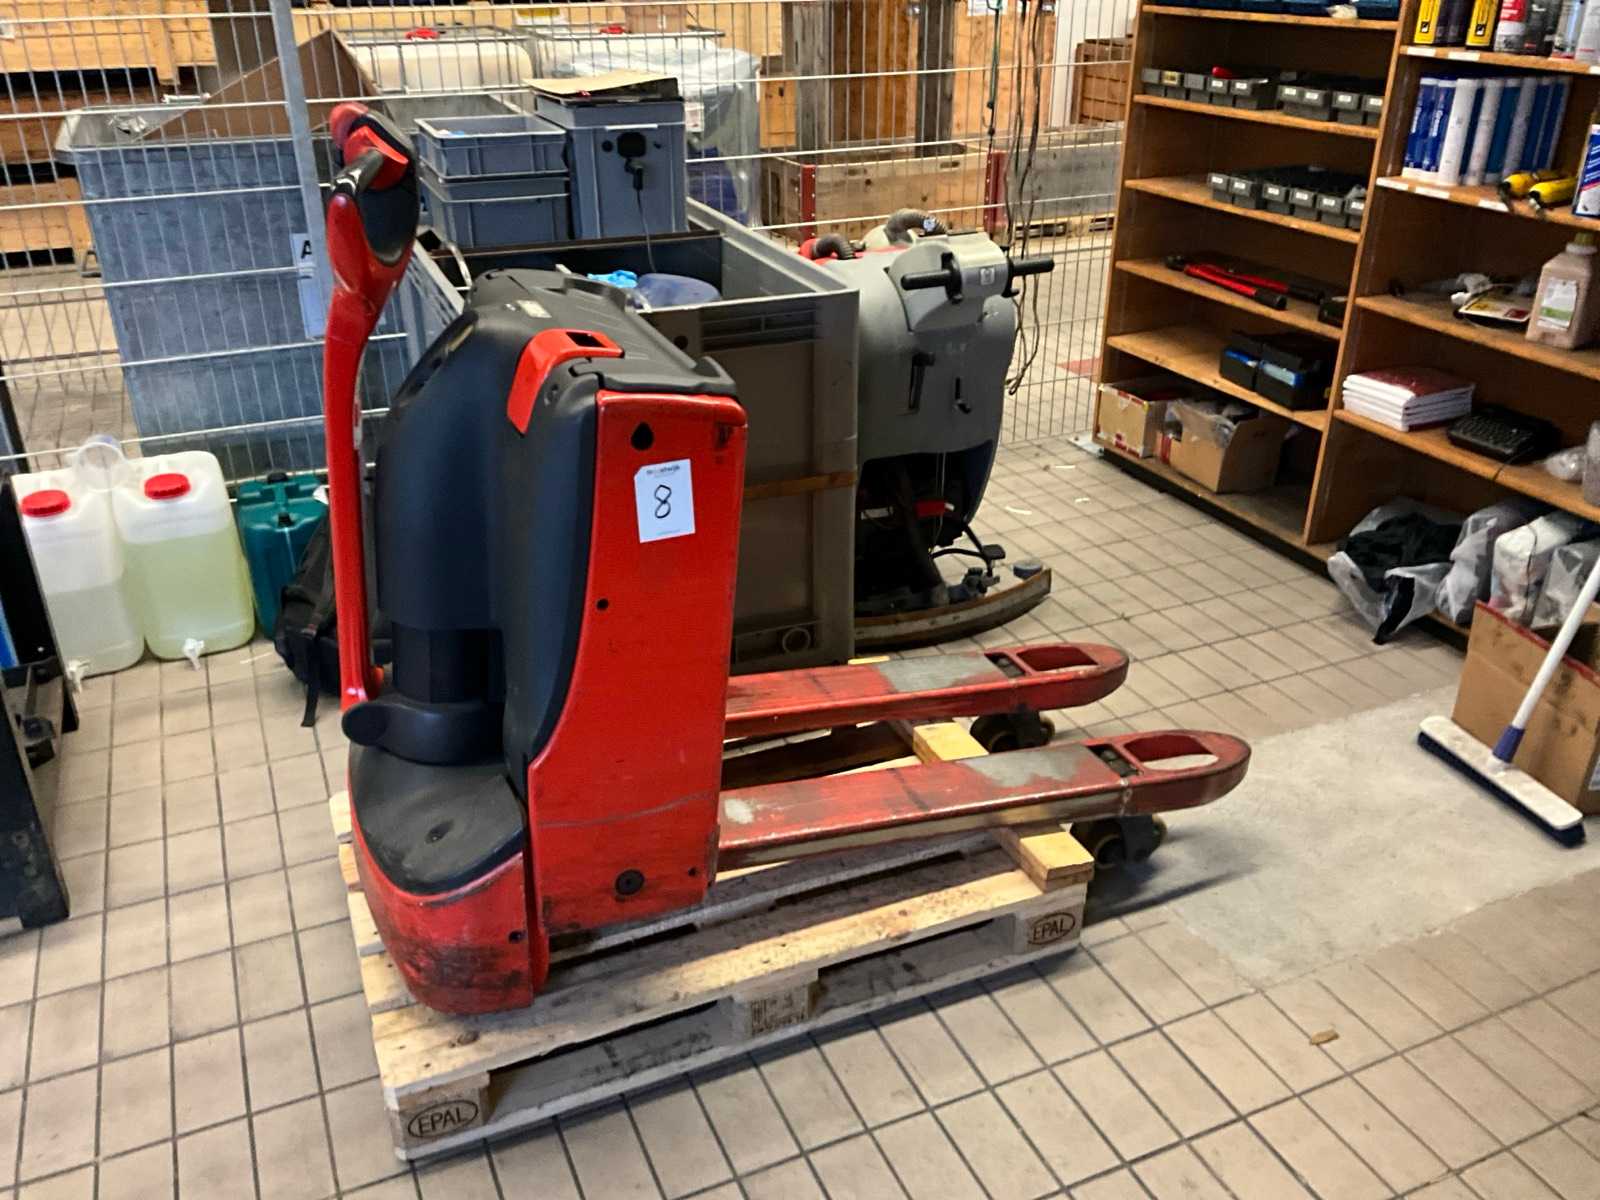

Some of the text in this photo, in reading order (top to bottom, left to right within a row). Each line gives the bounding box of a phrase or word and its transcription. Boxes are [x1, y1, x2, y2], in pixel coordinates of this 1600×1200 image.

[654, 484, 672, 519] 8
[1032, 918, 1070, 943] EPAL
[418, 1106, 468, 1135] EPAL
